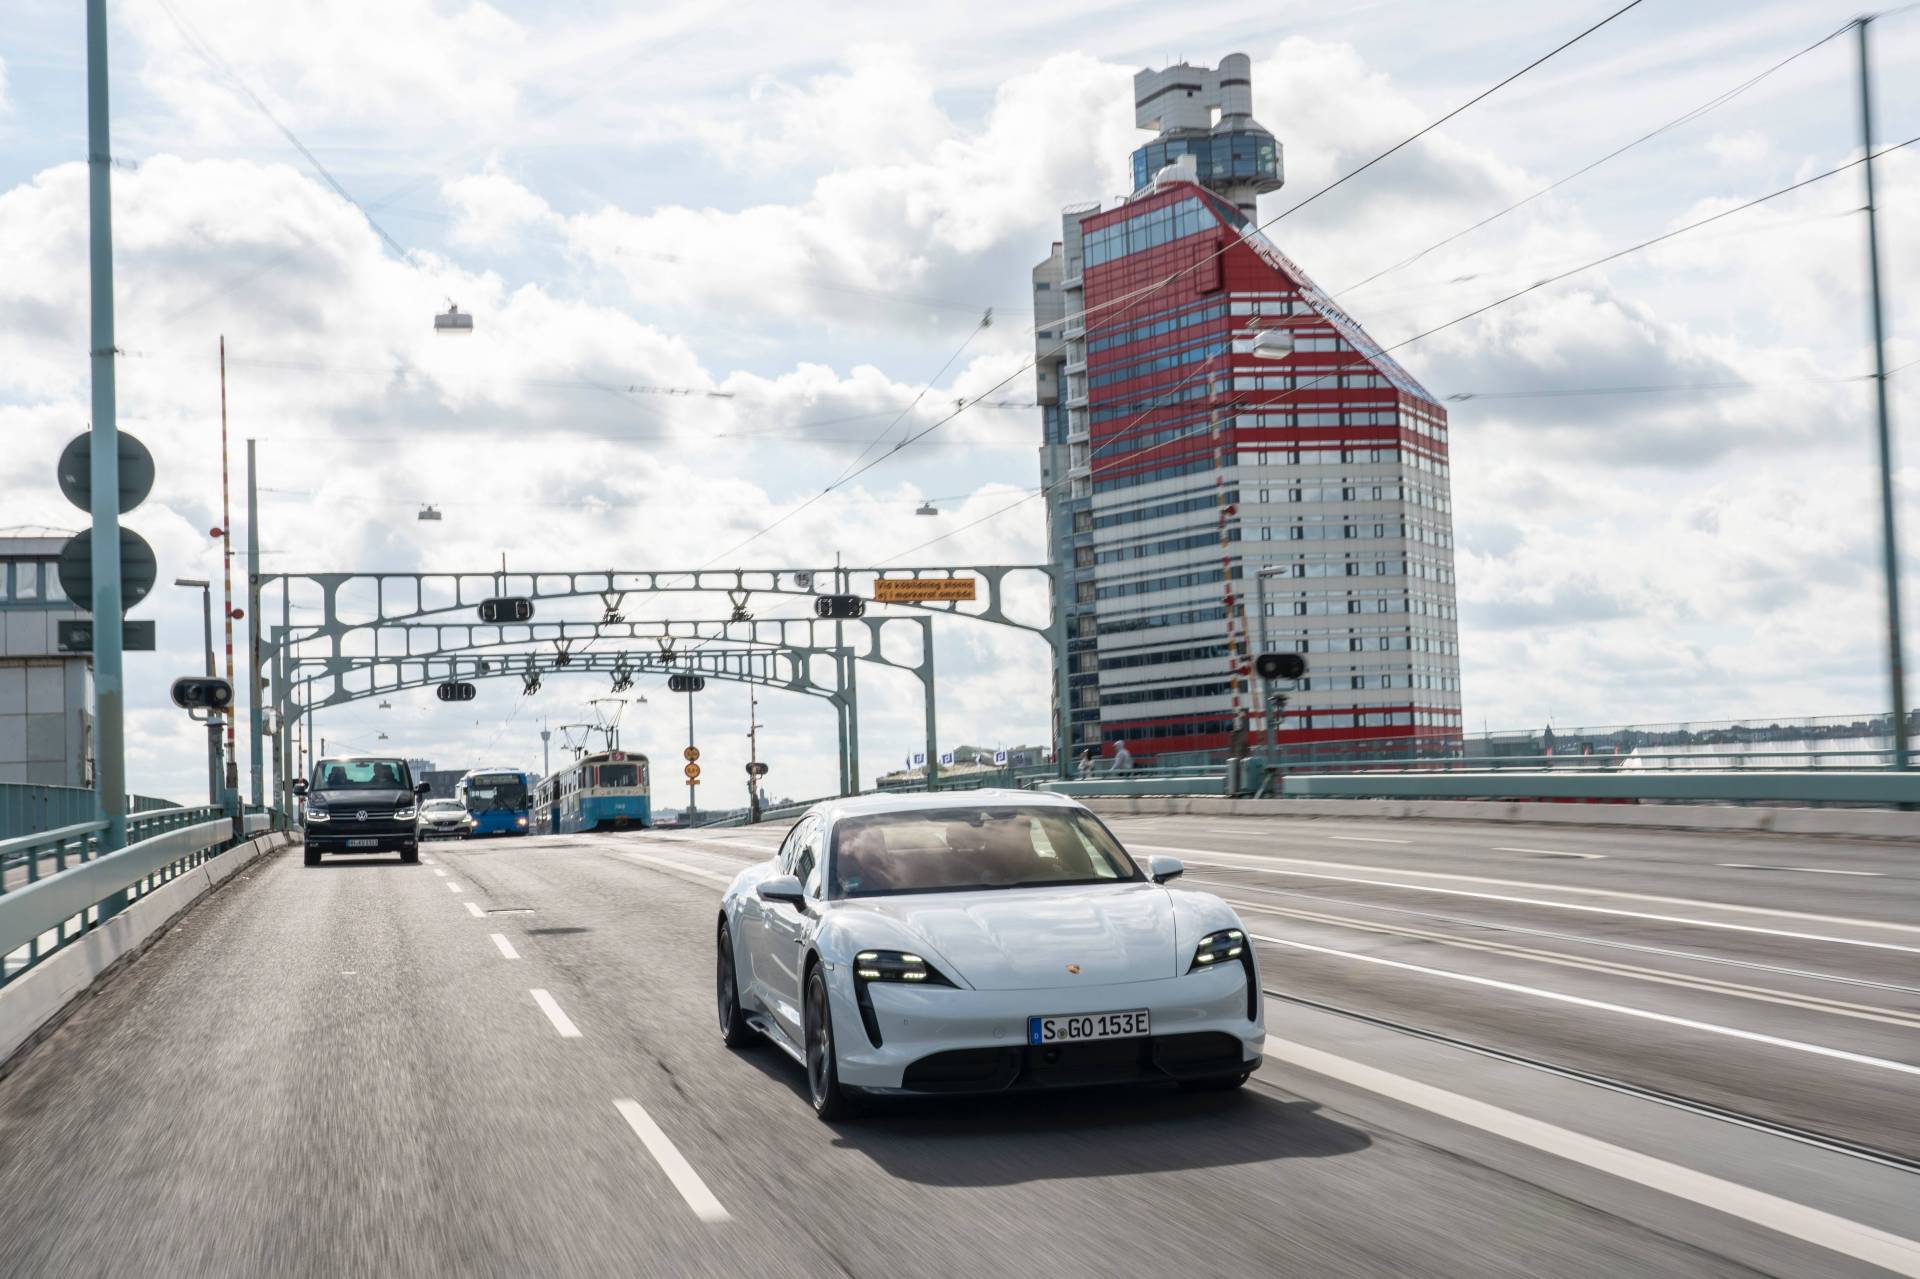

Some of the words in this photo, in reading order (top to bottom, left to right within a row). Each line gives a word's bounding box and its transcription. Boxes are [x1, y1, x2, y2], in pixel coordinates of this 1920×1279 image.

[1044, 1020, 1056, 1040] S
[1068, 1018, 1093, 1038] GO
[1098, 1013, 1148, 1036] 153E
